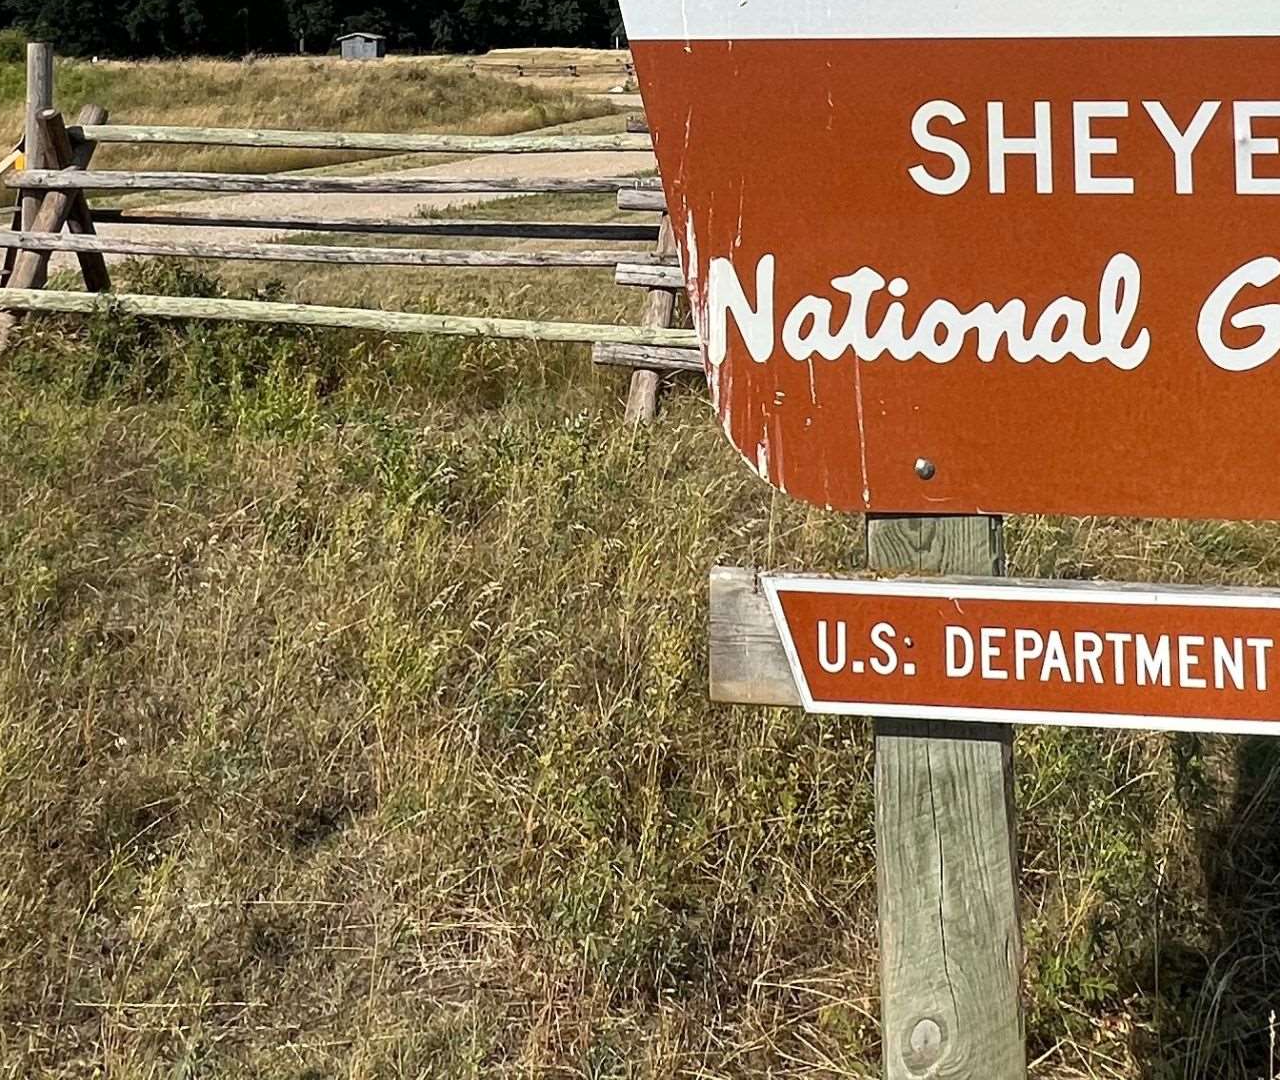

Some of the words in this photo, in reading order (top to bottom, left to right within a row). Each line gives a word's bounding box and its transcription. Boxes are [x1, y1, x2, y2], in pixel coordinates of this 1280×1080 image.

[708, 252, 1151, 370] National
[817, 620, 916, 675] U.S.
[945, 625, 1274, 691] DEPARTMENT
